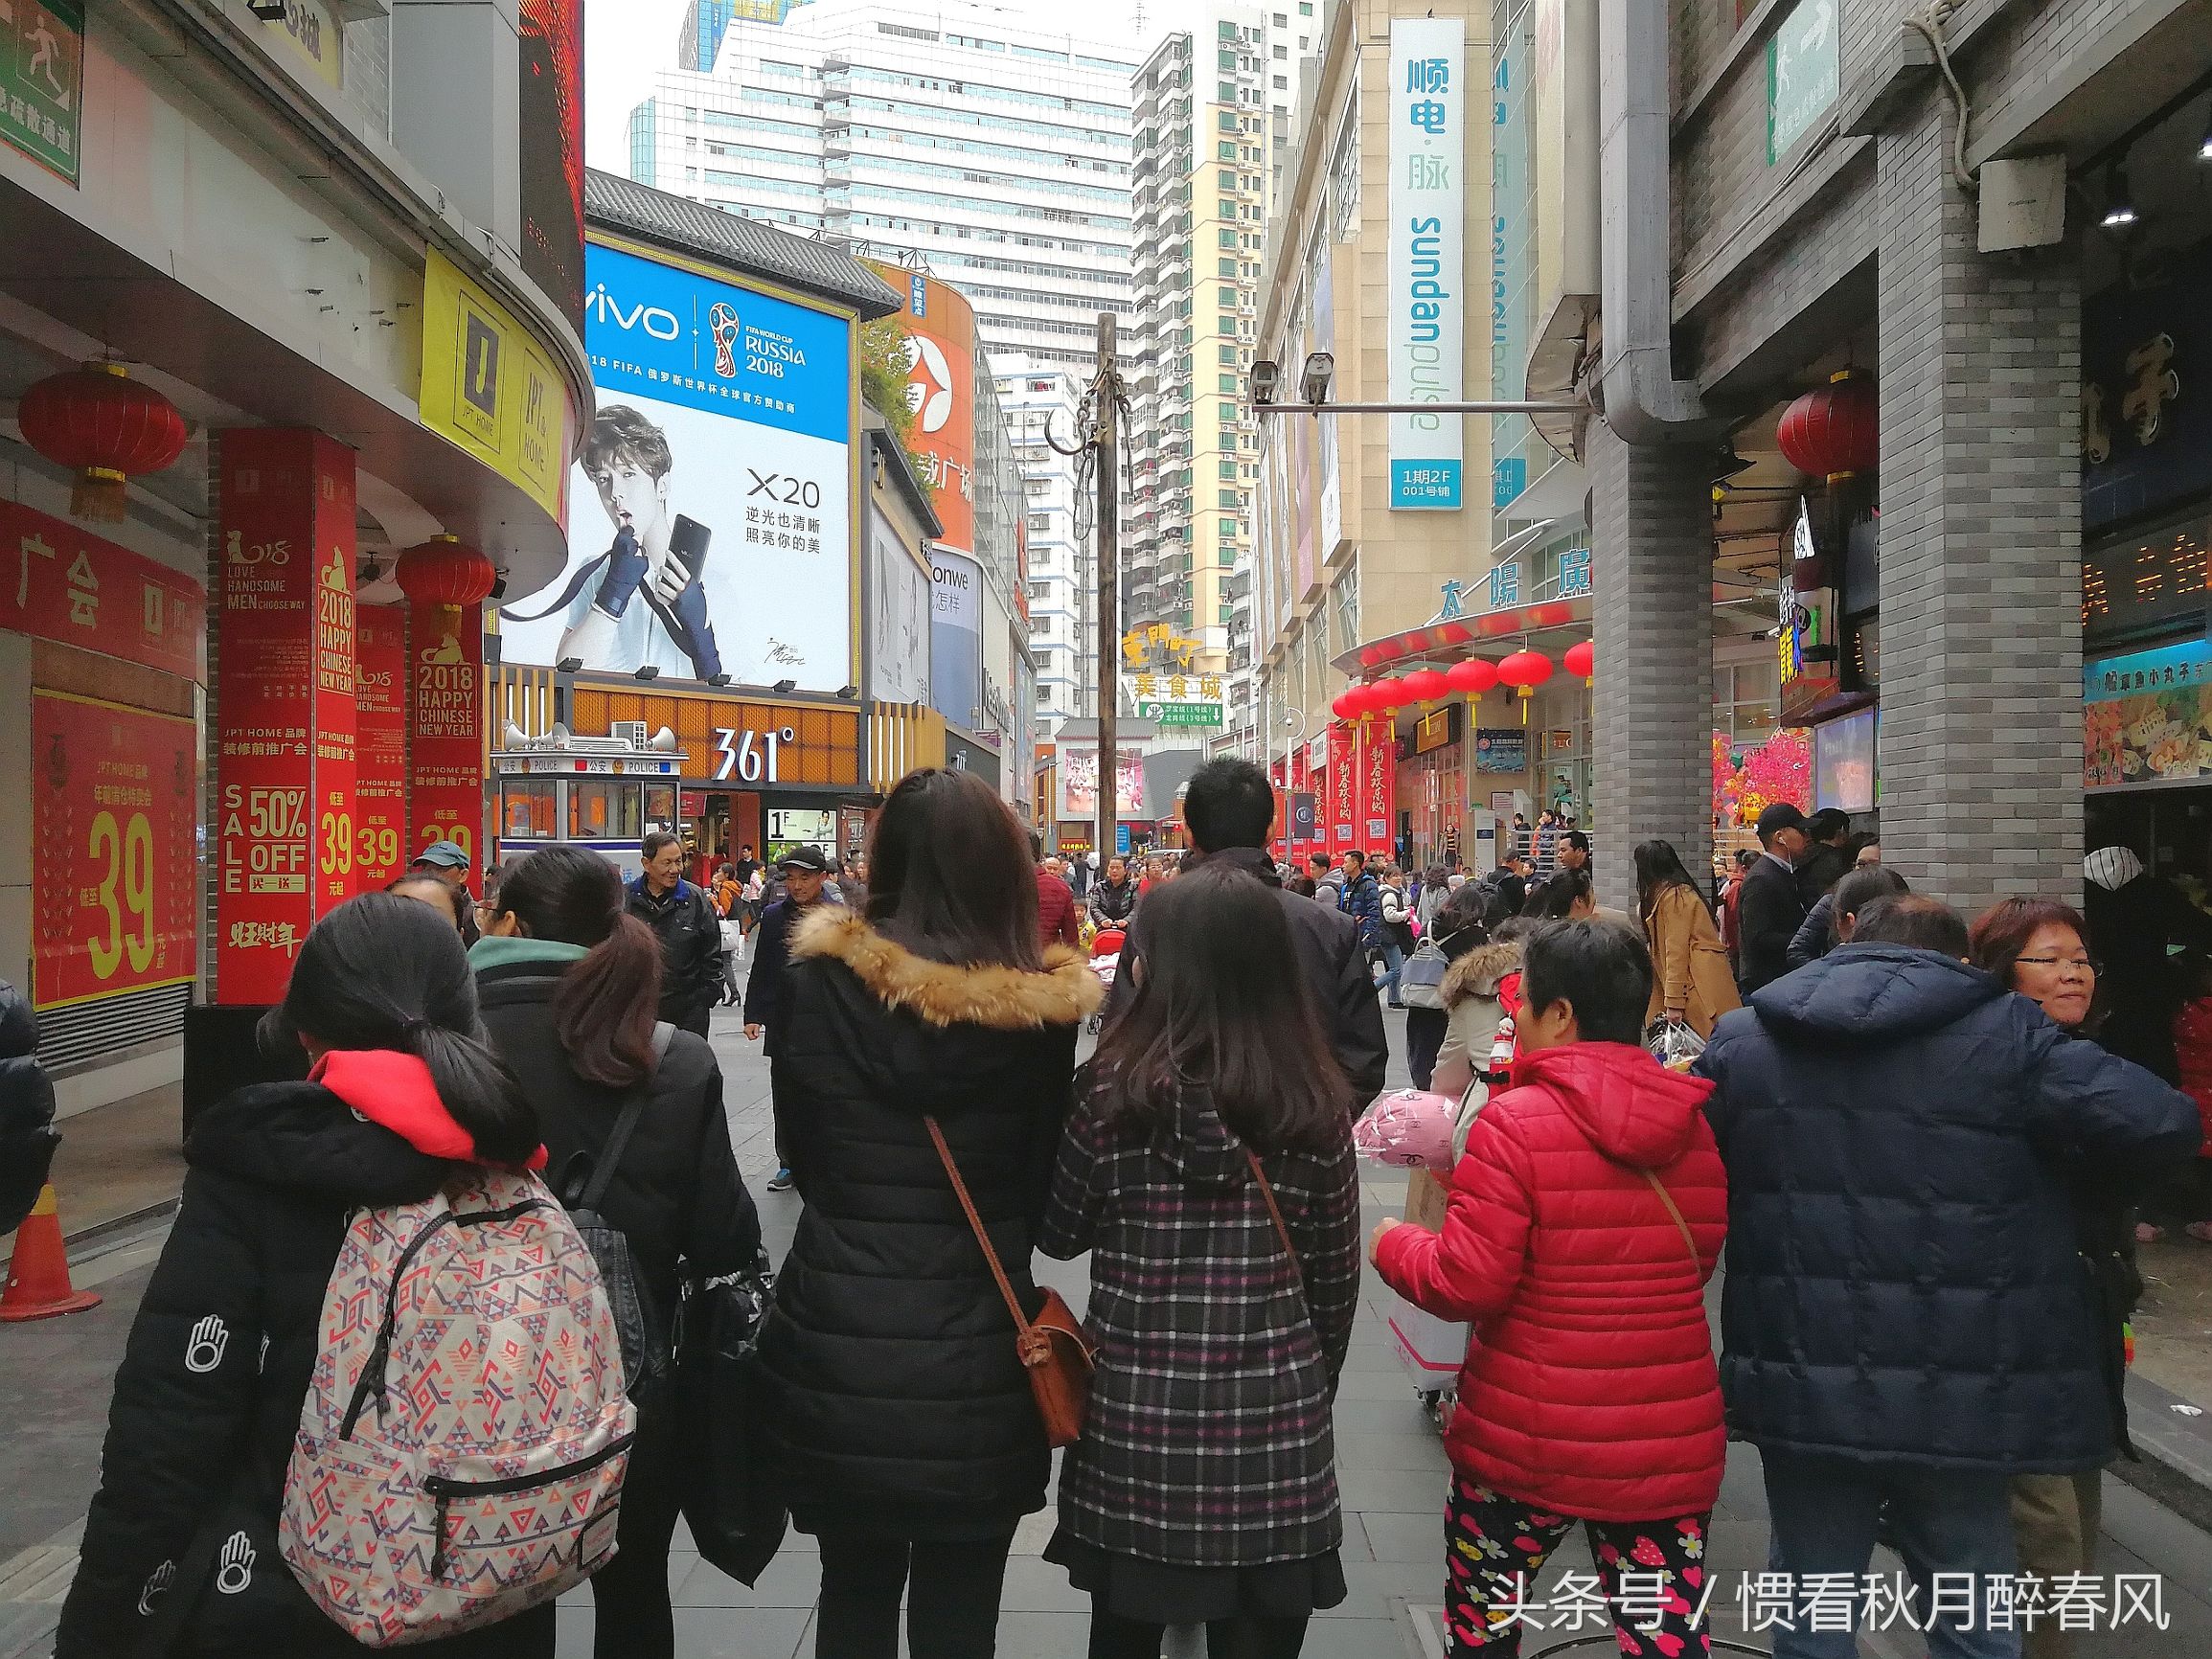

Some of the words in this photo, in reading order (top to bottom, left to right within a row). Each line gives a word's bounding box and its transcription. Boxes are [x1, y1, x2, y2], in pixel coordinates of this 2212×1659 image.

[745, 334, 807, 367] RUSSIA
[745, 354, 785, 378] 2018
[613, 359, 643, 375] FIFA
[648, 367, 796, 414] 俄罗斯世界杯全球官方赞助商
[462, 403, 475, 420] JPT
[475, 414, 494, 438] HOME
[746, 467, 821, 509] X20
[1402, 469, 1451, 485] 1期2F
[1402, 486, 1450, 497] 001号铺
[745, 506, 821, 534] 逆光也清晰
[745, 527, 821, 554] 照亮你的美
[228, 566, 255, 578] LOVE
[228, 580, 286, 592] HANDSOME
[227, 594, 258, 610] MEN
[320, 589, 353, 629] 2018
[931, 589, 960, 614] 怎样
[320, 624, 353, 654] HAPPY
[320, 650, 353, 675] CHINESE
[320, 670, 335, 689] NEW
[335, 673, 353, 693] YEAR
[419, 666, 473, 691] 2018
[1134, 672, 1222, 700] 美食城
[419, 690, 474, 709] HAPPY
[420, 709, 473, 724] CHINESE
[224, 728, 243, 739] JPT
[247, 728, 283, 738] HOME
[285, 727, 307, 739] 品牌
[317, 730, 329, 741] JPT
[328, 732, 345, 744] HOME
[419, 723, 443, 737] NEW
[445, 724, 473, 737] YEAR
[223, 741, 308, 756] 装修前推广会
[535, 760, 558, 771] POLICE
[589, 760, 606, 772] 公安
[628, 761, 659, 773] POLICE
[249, 790, 308, 838] 50%
[320, 811, 352, 875] 39
[355, 828, 398, 866] 39
[250, 844, 307, 872] OFF
[87, 810, 155, 980] 39
